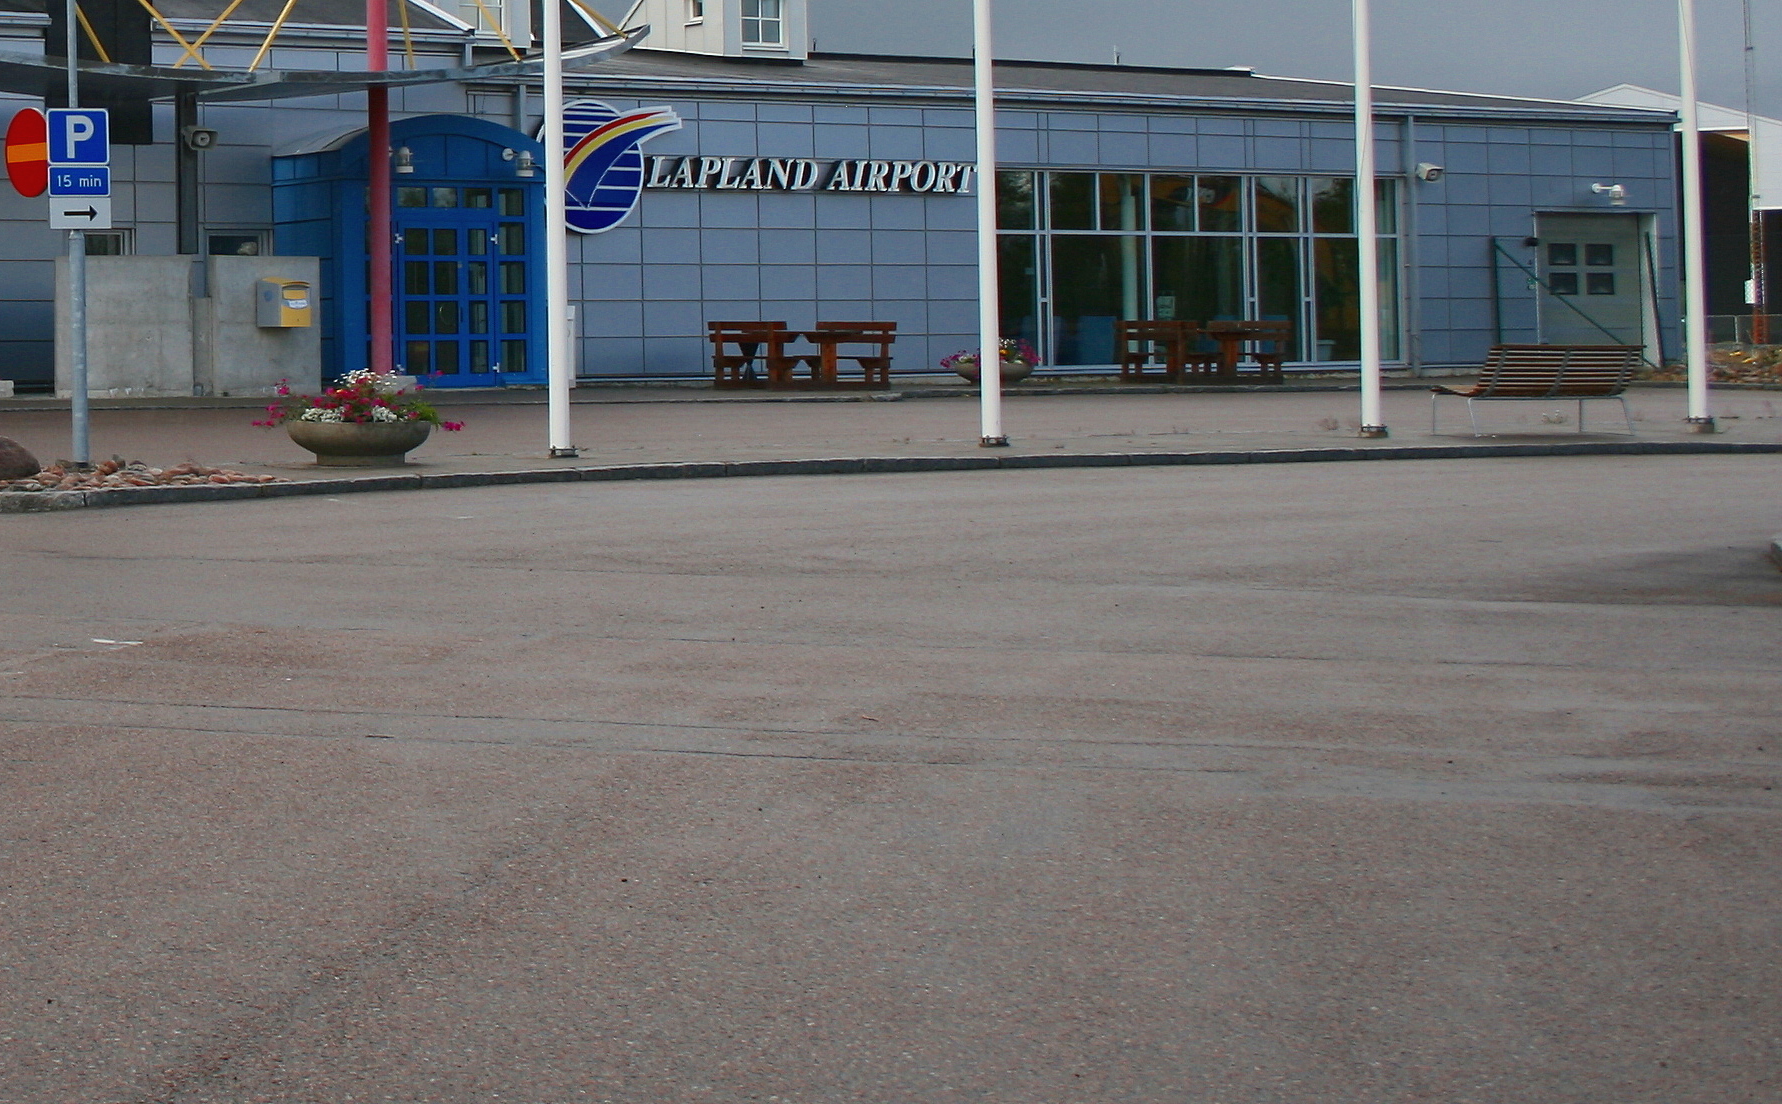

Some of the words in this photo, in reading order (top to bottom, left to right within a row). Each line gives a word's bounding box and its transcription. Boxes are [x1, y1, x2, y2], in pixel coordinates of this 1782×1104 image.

[65, 114, 95, 159] P
[57, 174, 72, 187] 15
[79, 174, 102, 187] min
[646, 155, 819, 191] LAPLAND
[826, 160, 978, 194] AIRPORT
